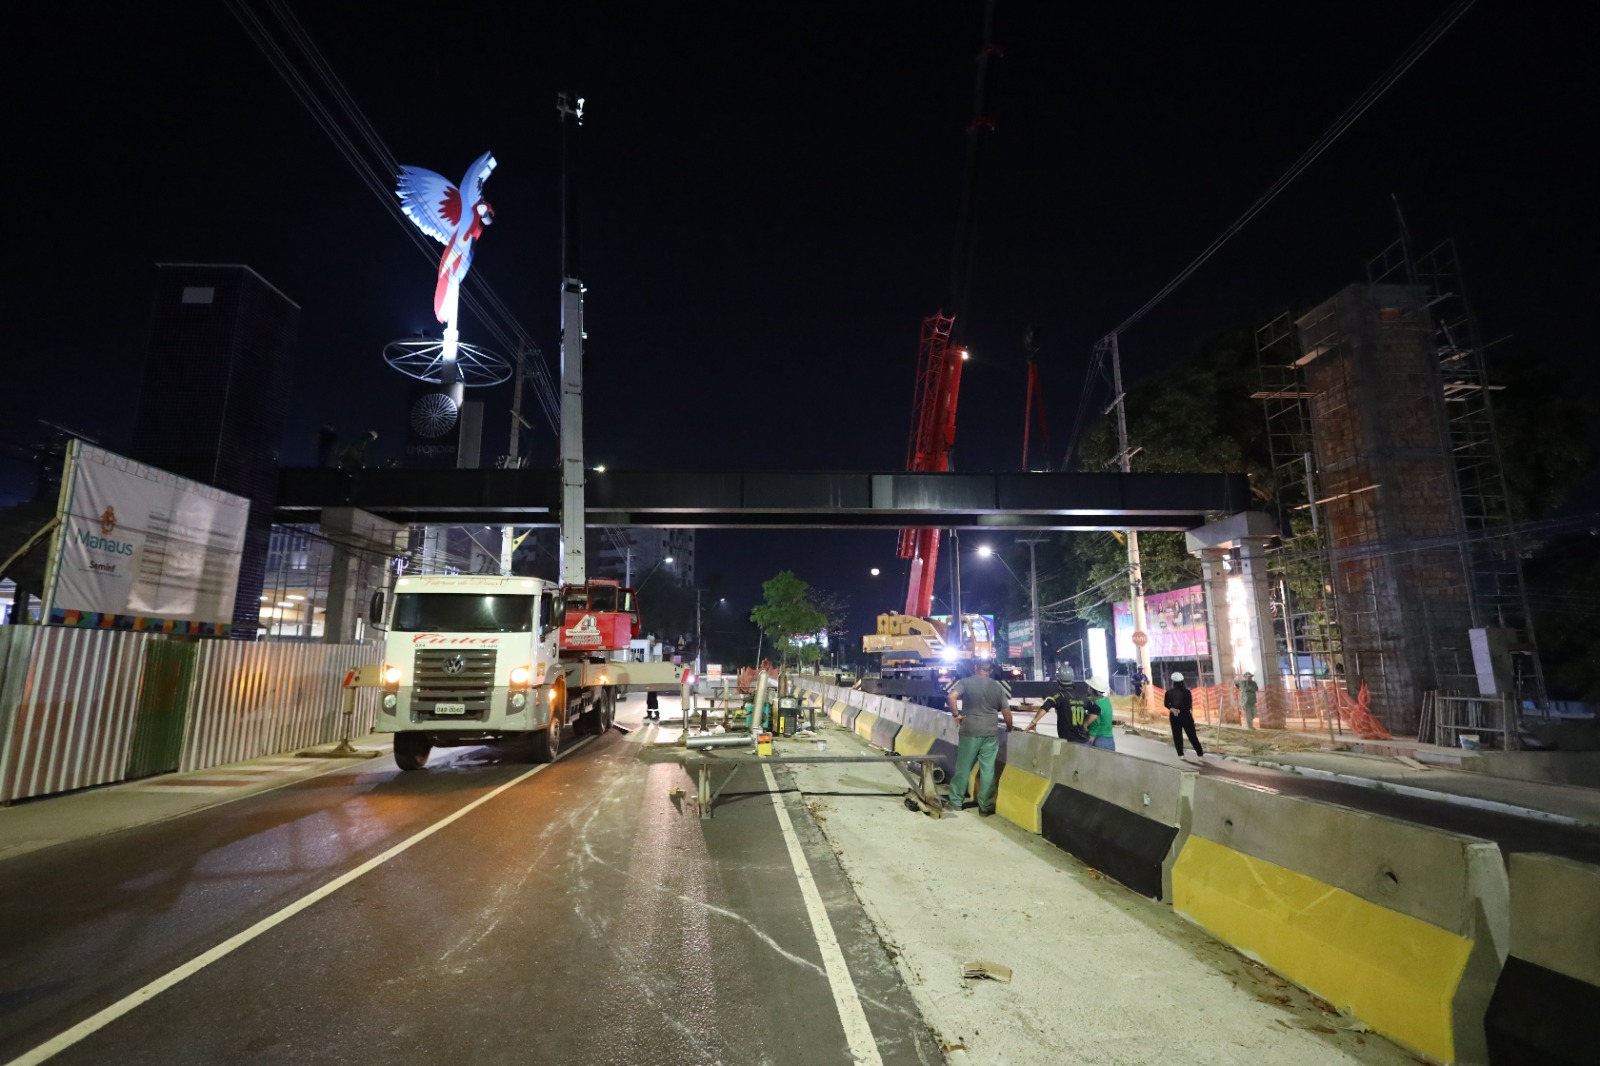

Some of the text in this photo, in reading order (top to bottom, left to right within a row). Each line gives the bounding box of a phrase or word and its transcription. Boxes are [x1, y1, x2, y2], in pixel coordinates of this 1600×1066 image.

[75, 528, 133, 556] Manaus
[89, 560, 116, 573] Seminf
[1071, 706, 1084, 726] 10
